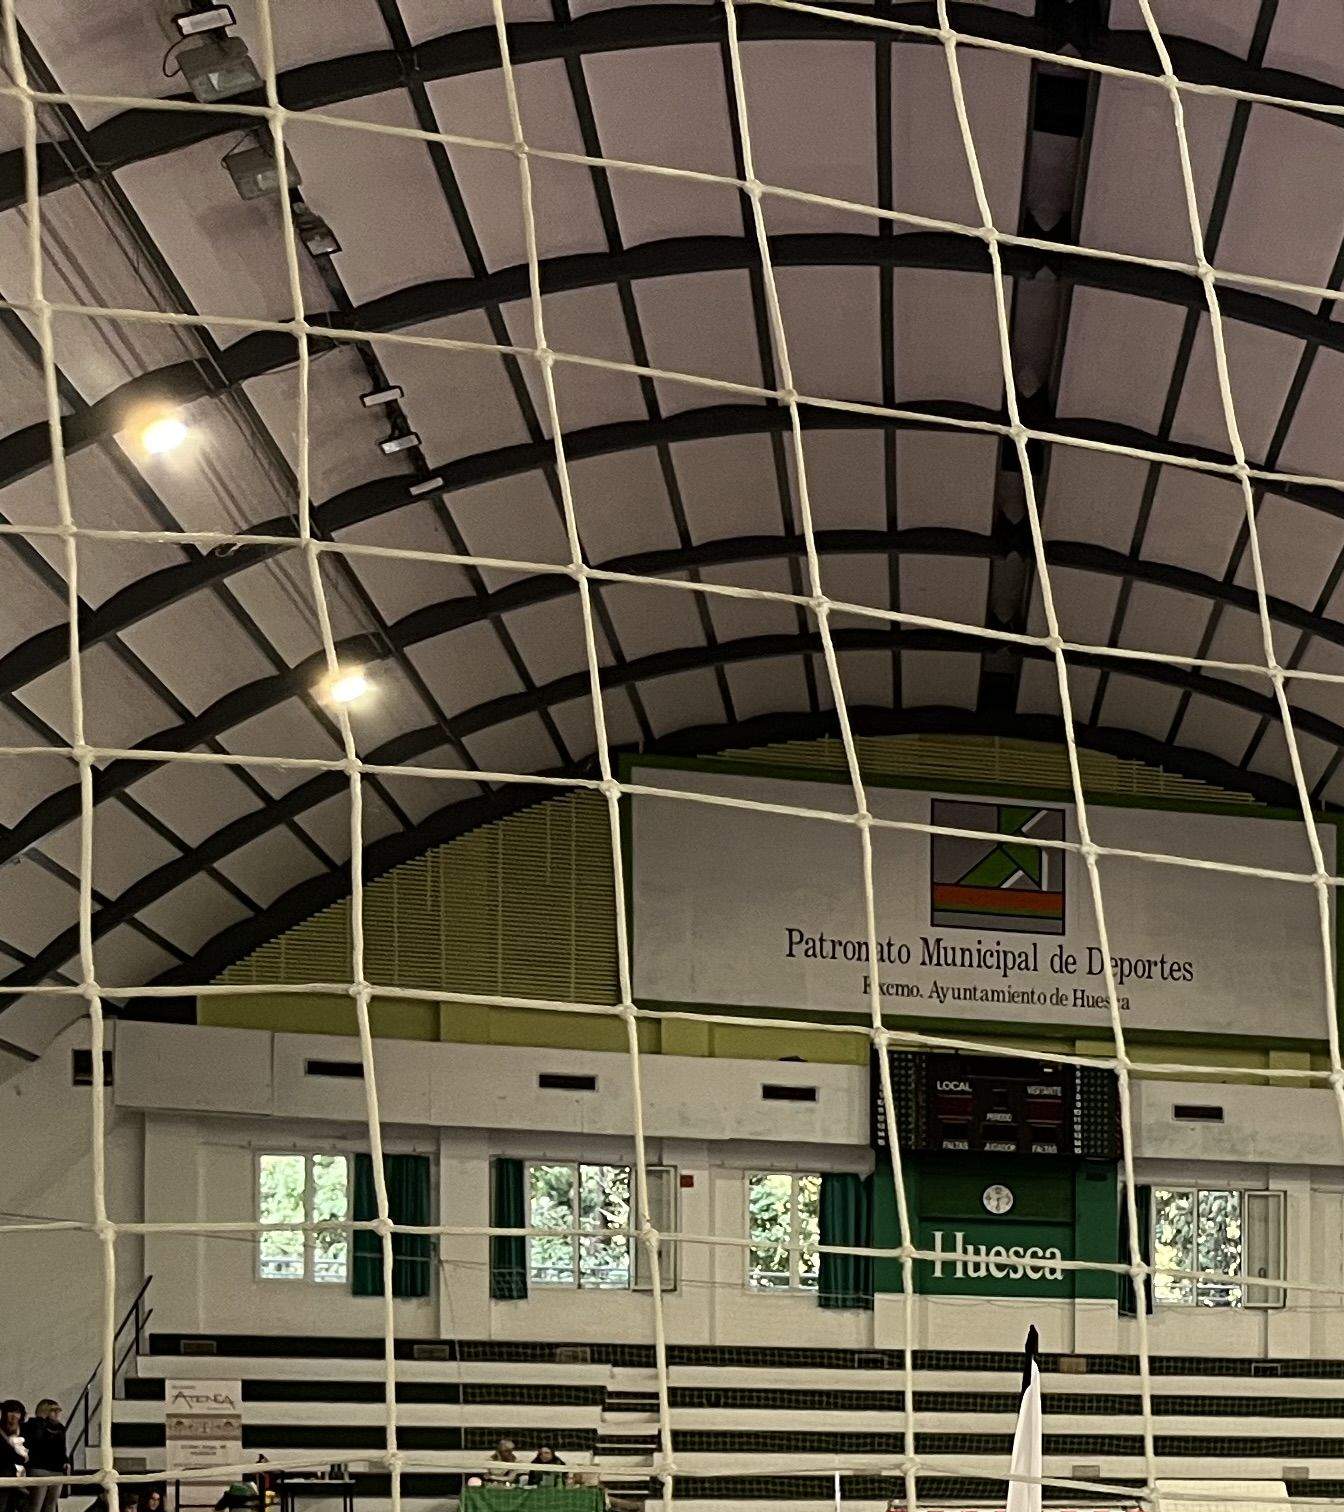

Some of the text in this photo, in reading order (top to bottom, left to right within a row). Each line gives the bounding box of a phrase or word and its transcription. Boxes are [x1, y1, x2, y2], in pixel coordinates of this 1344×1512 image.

[919, 936, 1038, 977] Municipal
[1051, 944, 1077, 974] de
[1086, 946, 1194, 985] Deportes
[928, 980, 1046, 1005] Ayuntamiento
[1050, 987, 1068, 1007] de
[1072, 988, 1130, 1010] Huesa
[937, 1080, 972, 1092] LOCAL
[932, 1231, 1064, 1280] Huesca
